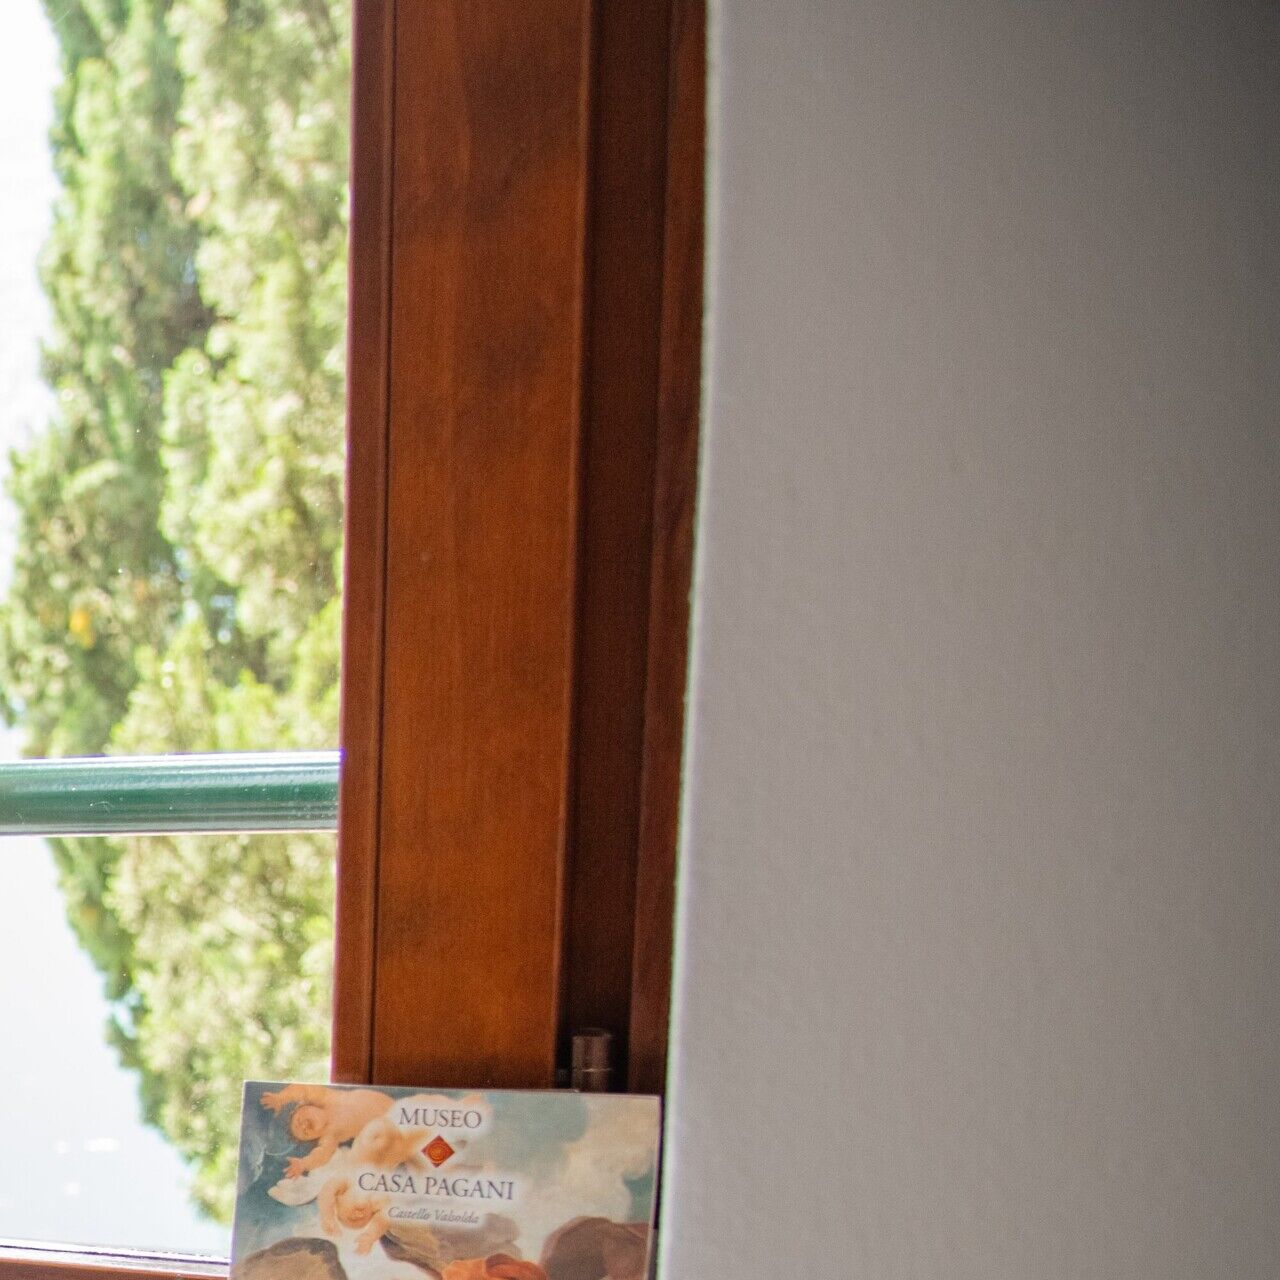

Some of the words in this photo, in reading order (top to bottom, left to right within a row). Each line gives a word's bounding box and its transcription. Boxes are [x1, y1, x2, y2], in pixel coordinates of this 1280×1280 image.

[399, 1107, 482, 1129] MUSEO
[357, 1173, 417, 1195] CASA
[425, 1176, 515, 1201] PAGANI
[387, 1206, 431, 1221] Castello
[434, 1209, 480, 1225] Valsolda
